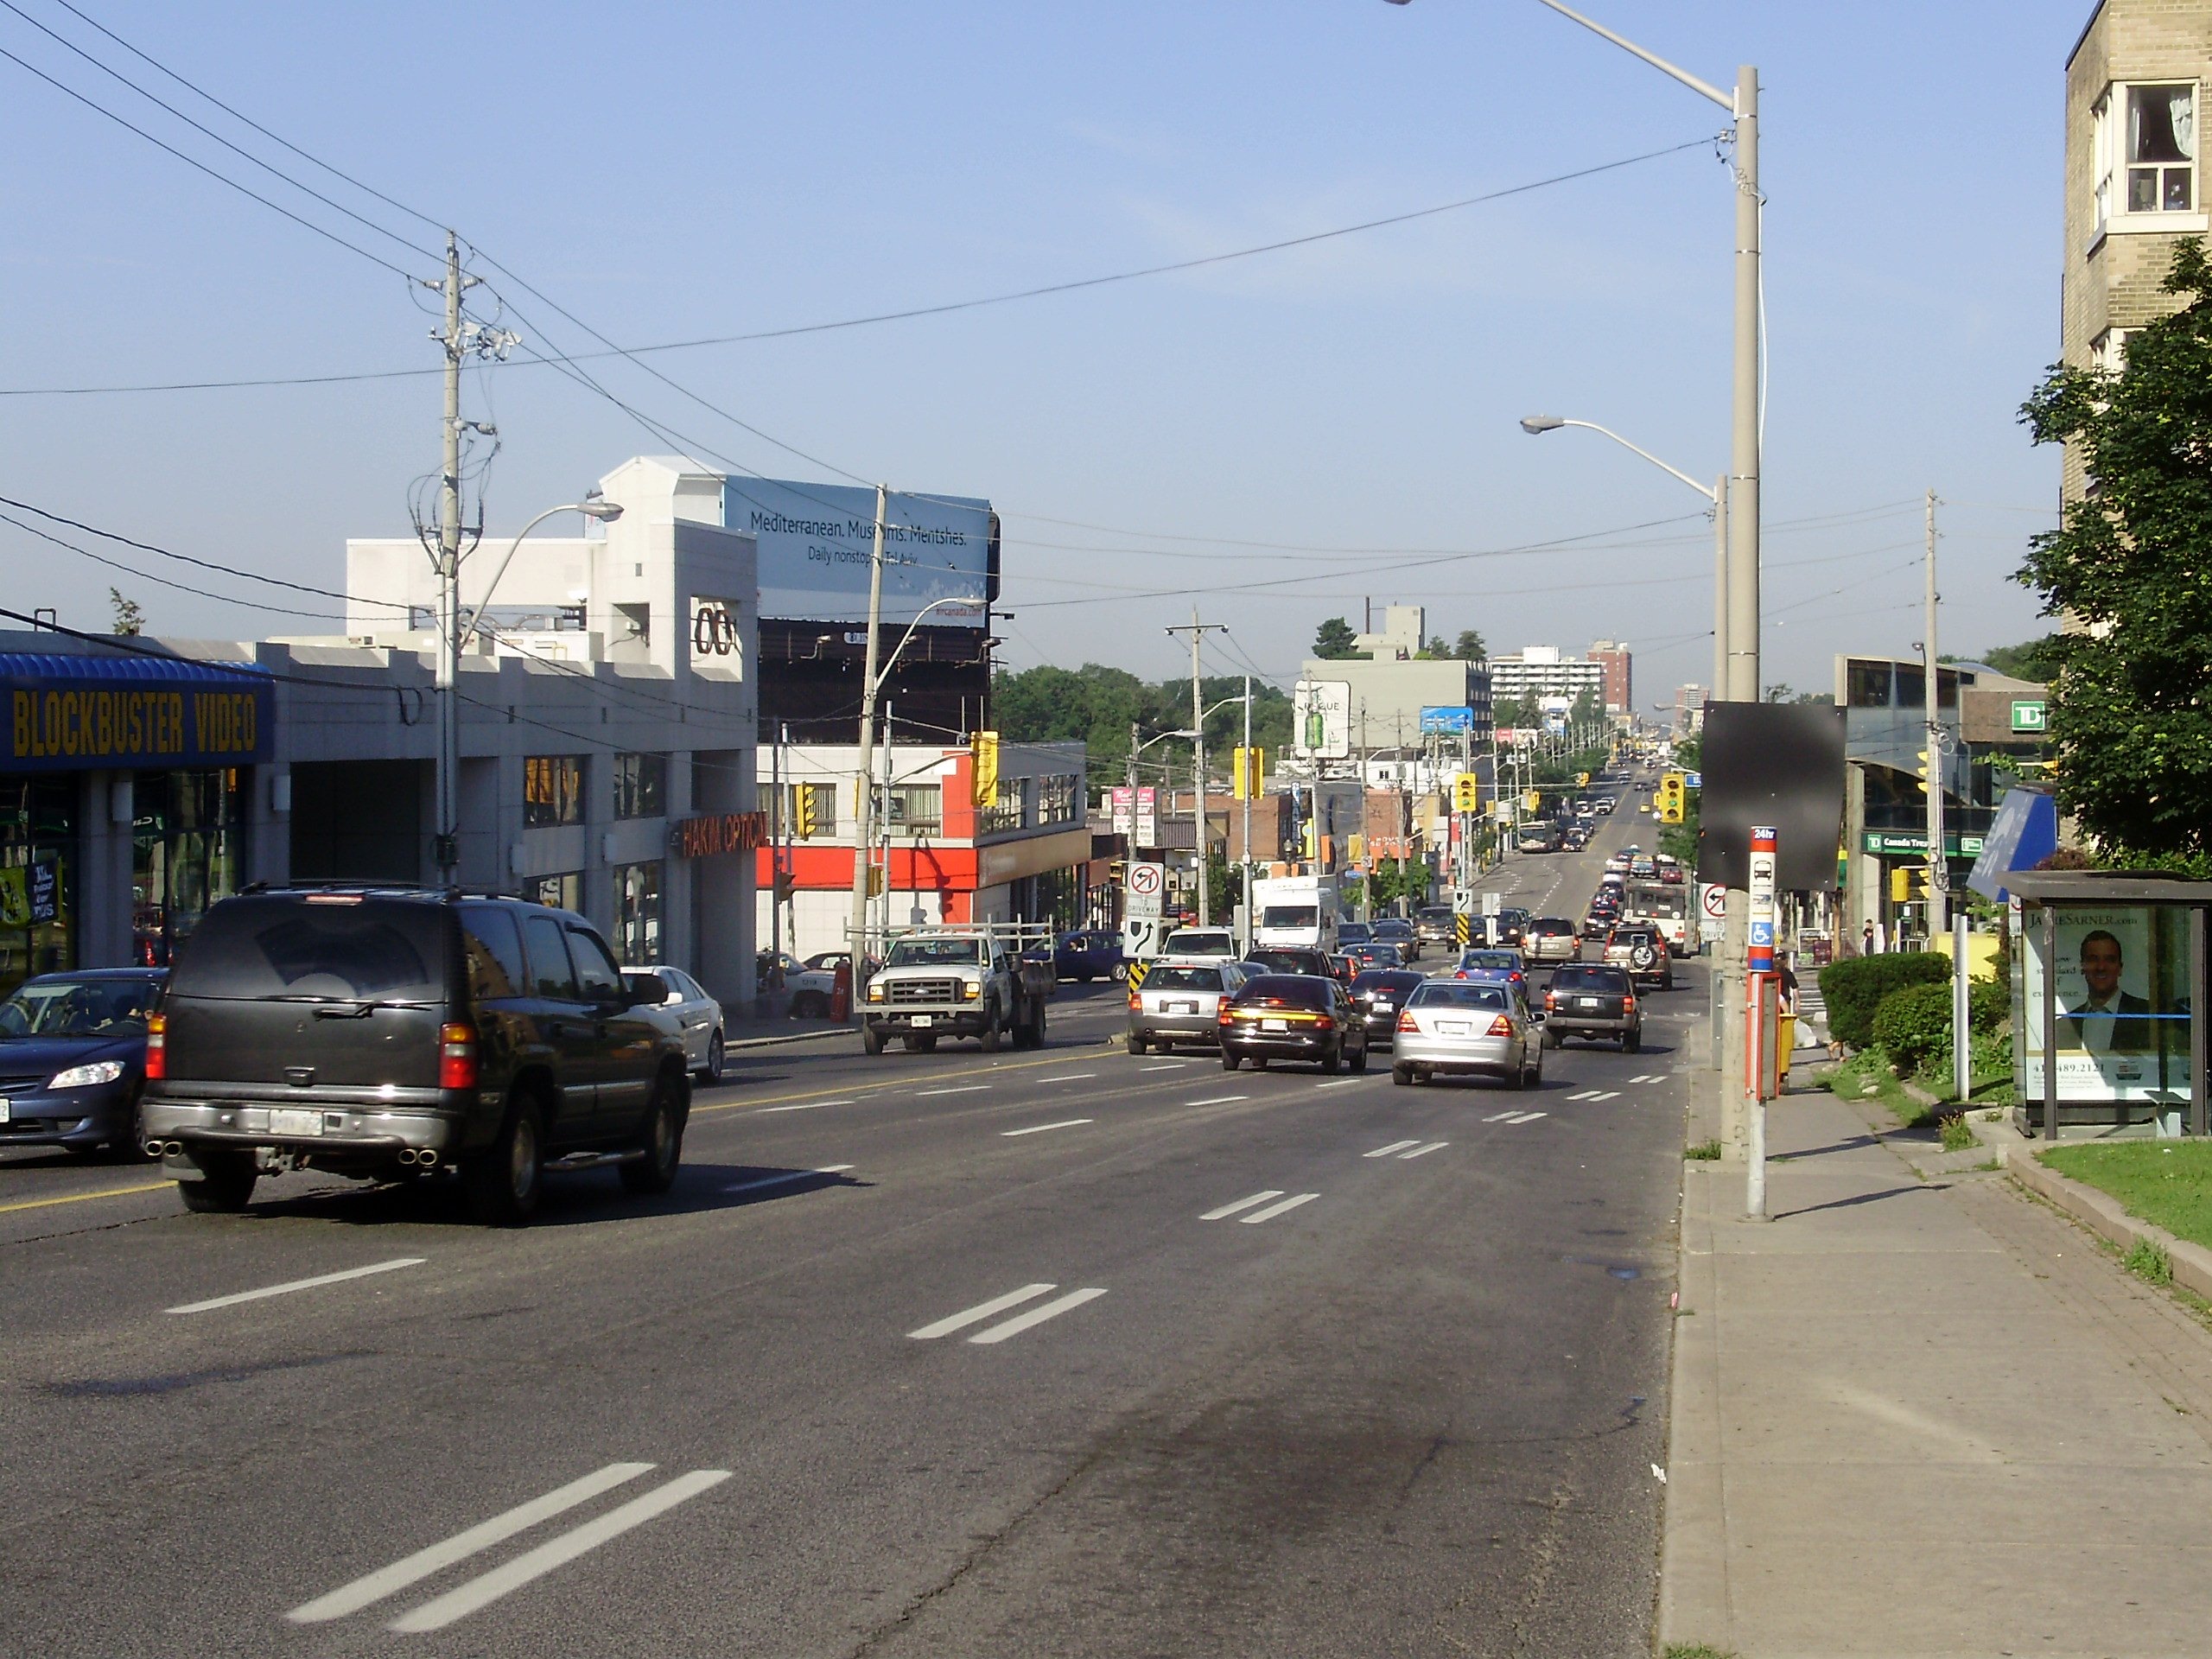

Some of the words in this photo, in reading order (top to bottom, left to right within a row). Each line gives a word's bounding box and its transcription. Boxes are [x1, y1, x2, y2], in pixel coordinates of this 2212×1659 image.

[750, 511, 844, 538] Mediterranean.
[849, 520, 907, 543] Musms.
[910, 524, 967, 546] Mentshes.
[808, 546, 832, 566] Daily
[835, 549, 872, 569] nonstop
[2015, 706, 2041, 724] TD
[13, 690, 184, 758] BLOCKBUSTER
[194, 692, 256, 753] VIDEO
[683, 816, 721, 857] HAKIM
[1754, 830, 1775, 840] 24hr
[1884, 838, 1910, 847] Canada
[1911, 839, 1929, 848] Trus
[1128, 905, 1159, 913] DRIVEWAY
[2030, 914, 2139, 929] JAIESARNER.com
[2033, 1064, 2105, 1072] 41489.2121
